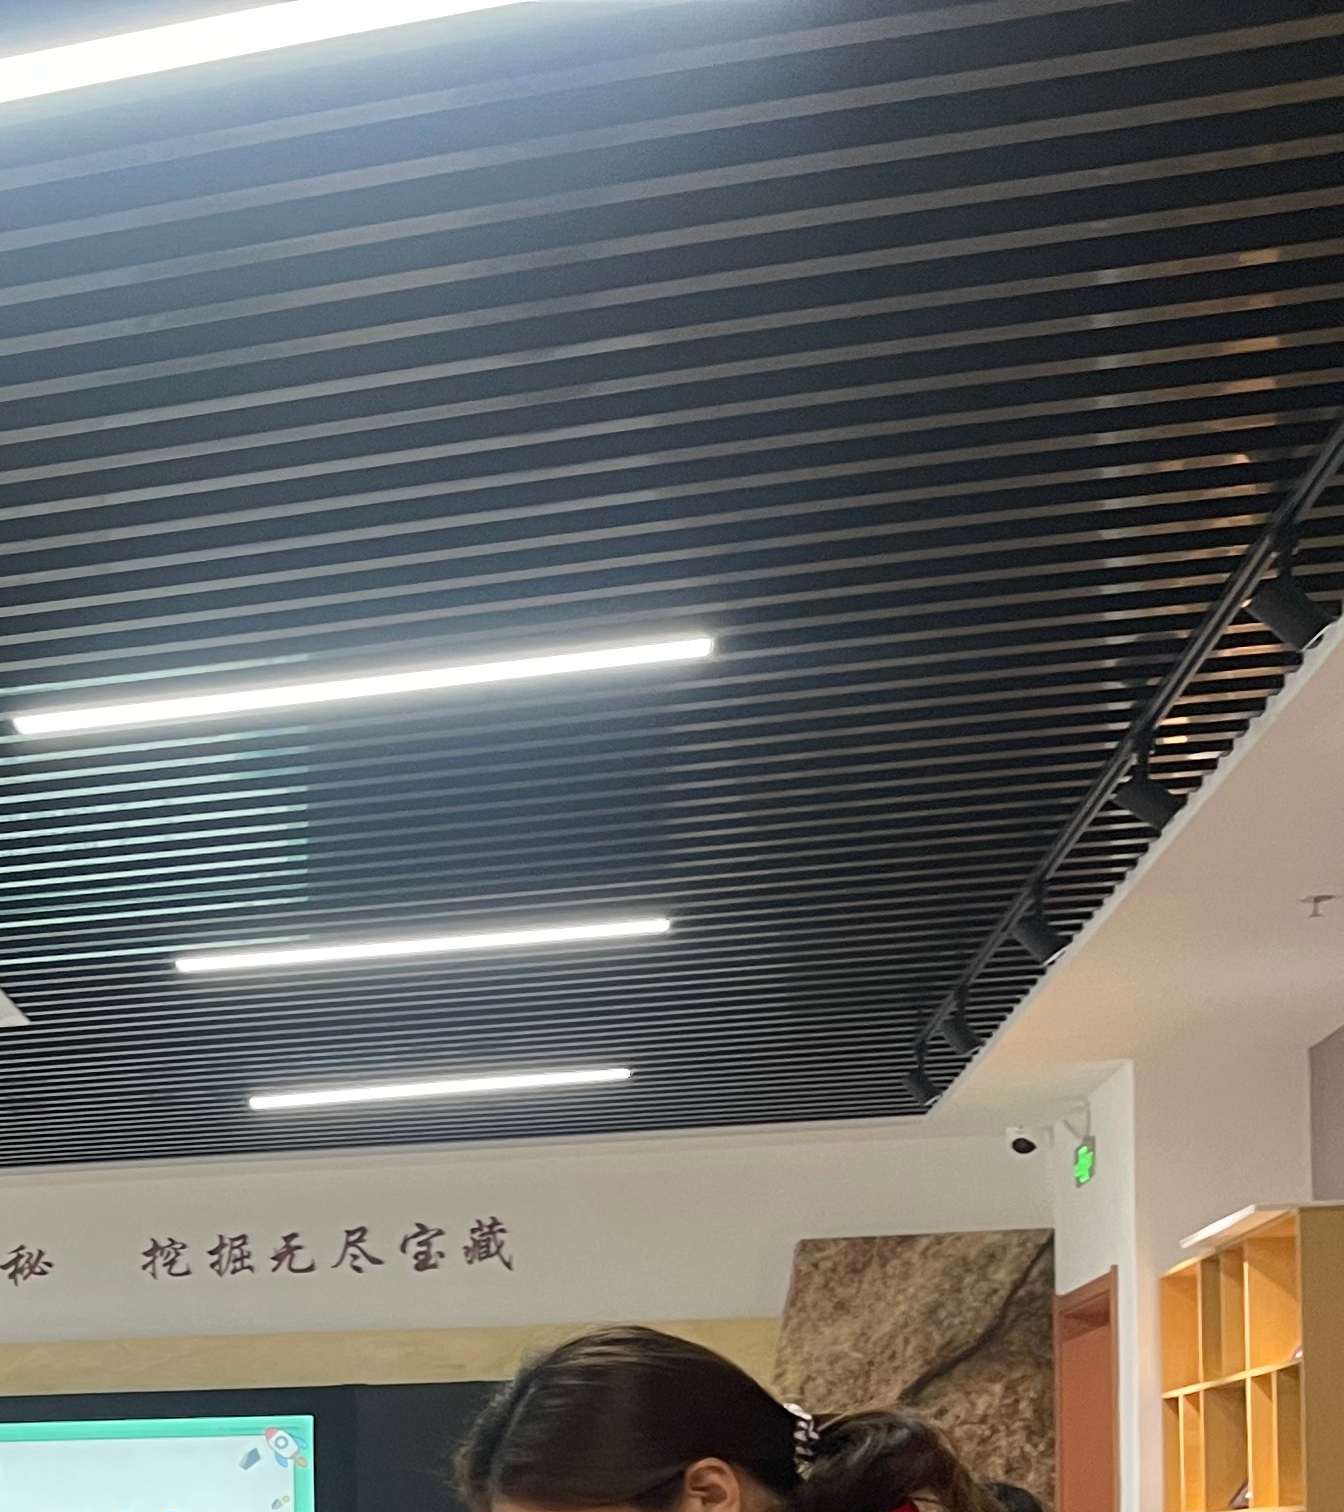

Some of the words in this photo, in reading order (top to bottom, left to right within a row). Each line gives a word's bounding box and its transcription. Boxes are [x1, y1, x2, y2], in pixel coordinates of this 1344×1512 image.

[141, 1216, 514, 1280] 挖掘无尽宝藏
